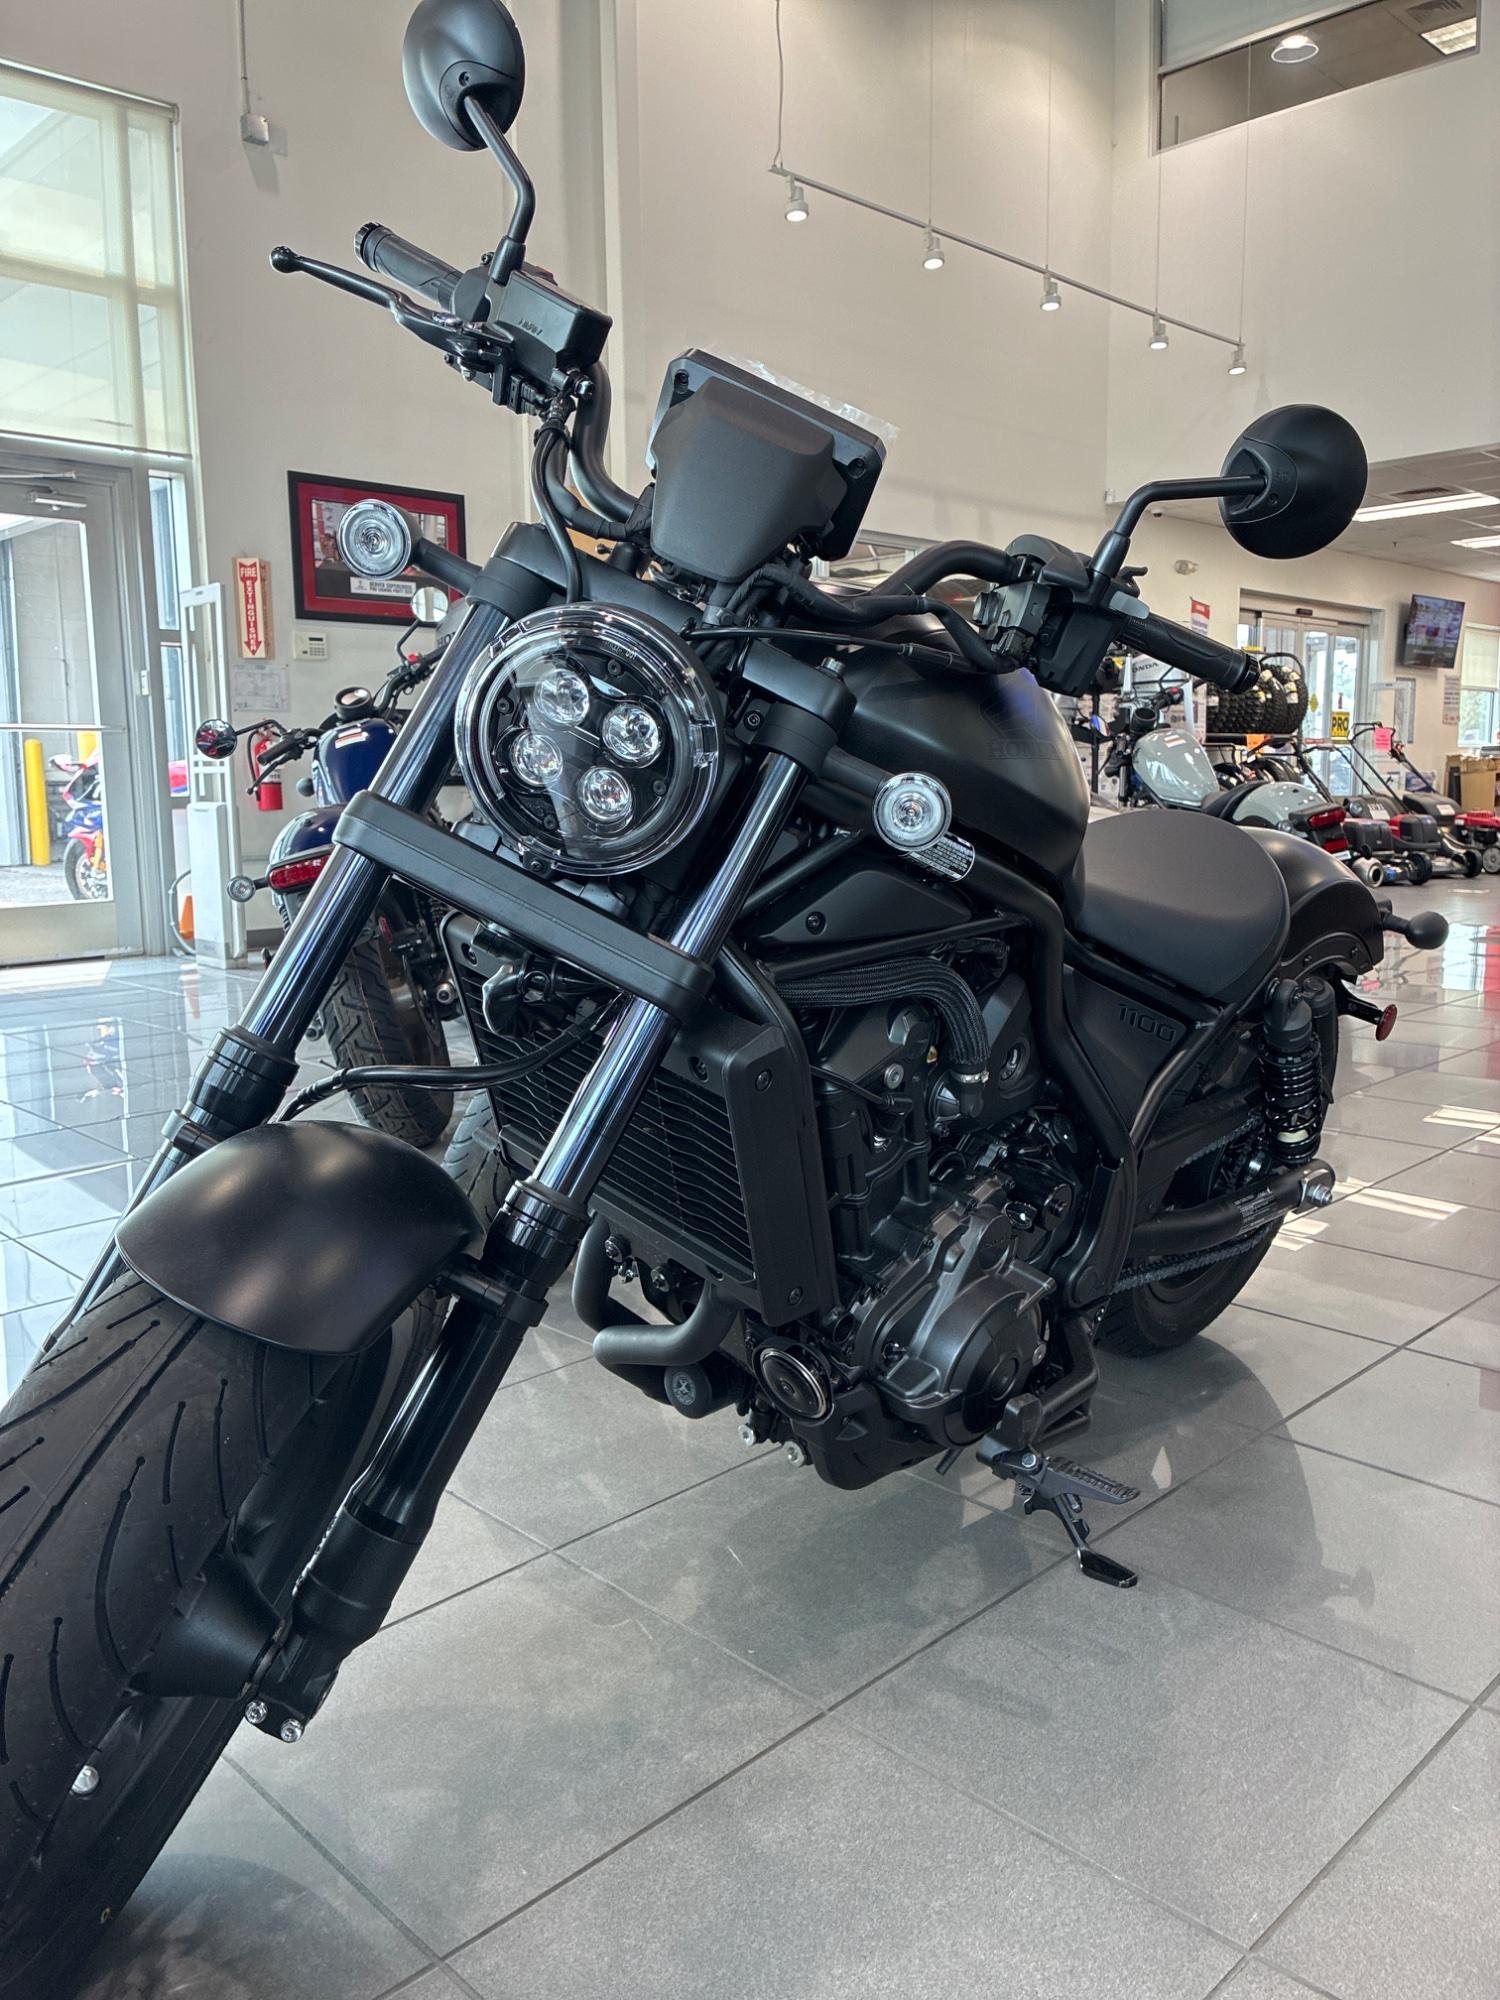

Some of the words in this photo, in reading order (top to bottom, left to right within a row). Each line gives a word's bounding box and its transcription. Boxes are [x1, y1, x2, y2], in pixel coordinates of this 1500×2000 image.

[240, 567, 257, 577] FIRE
[246, 580, 257, 651] EXTINGUISHER
[1132, 662, 1159, 674] ONDA
[1331, 717, 1349, 732] PRO
[1118, 1003, 1177, 1042] 1100
